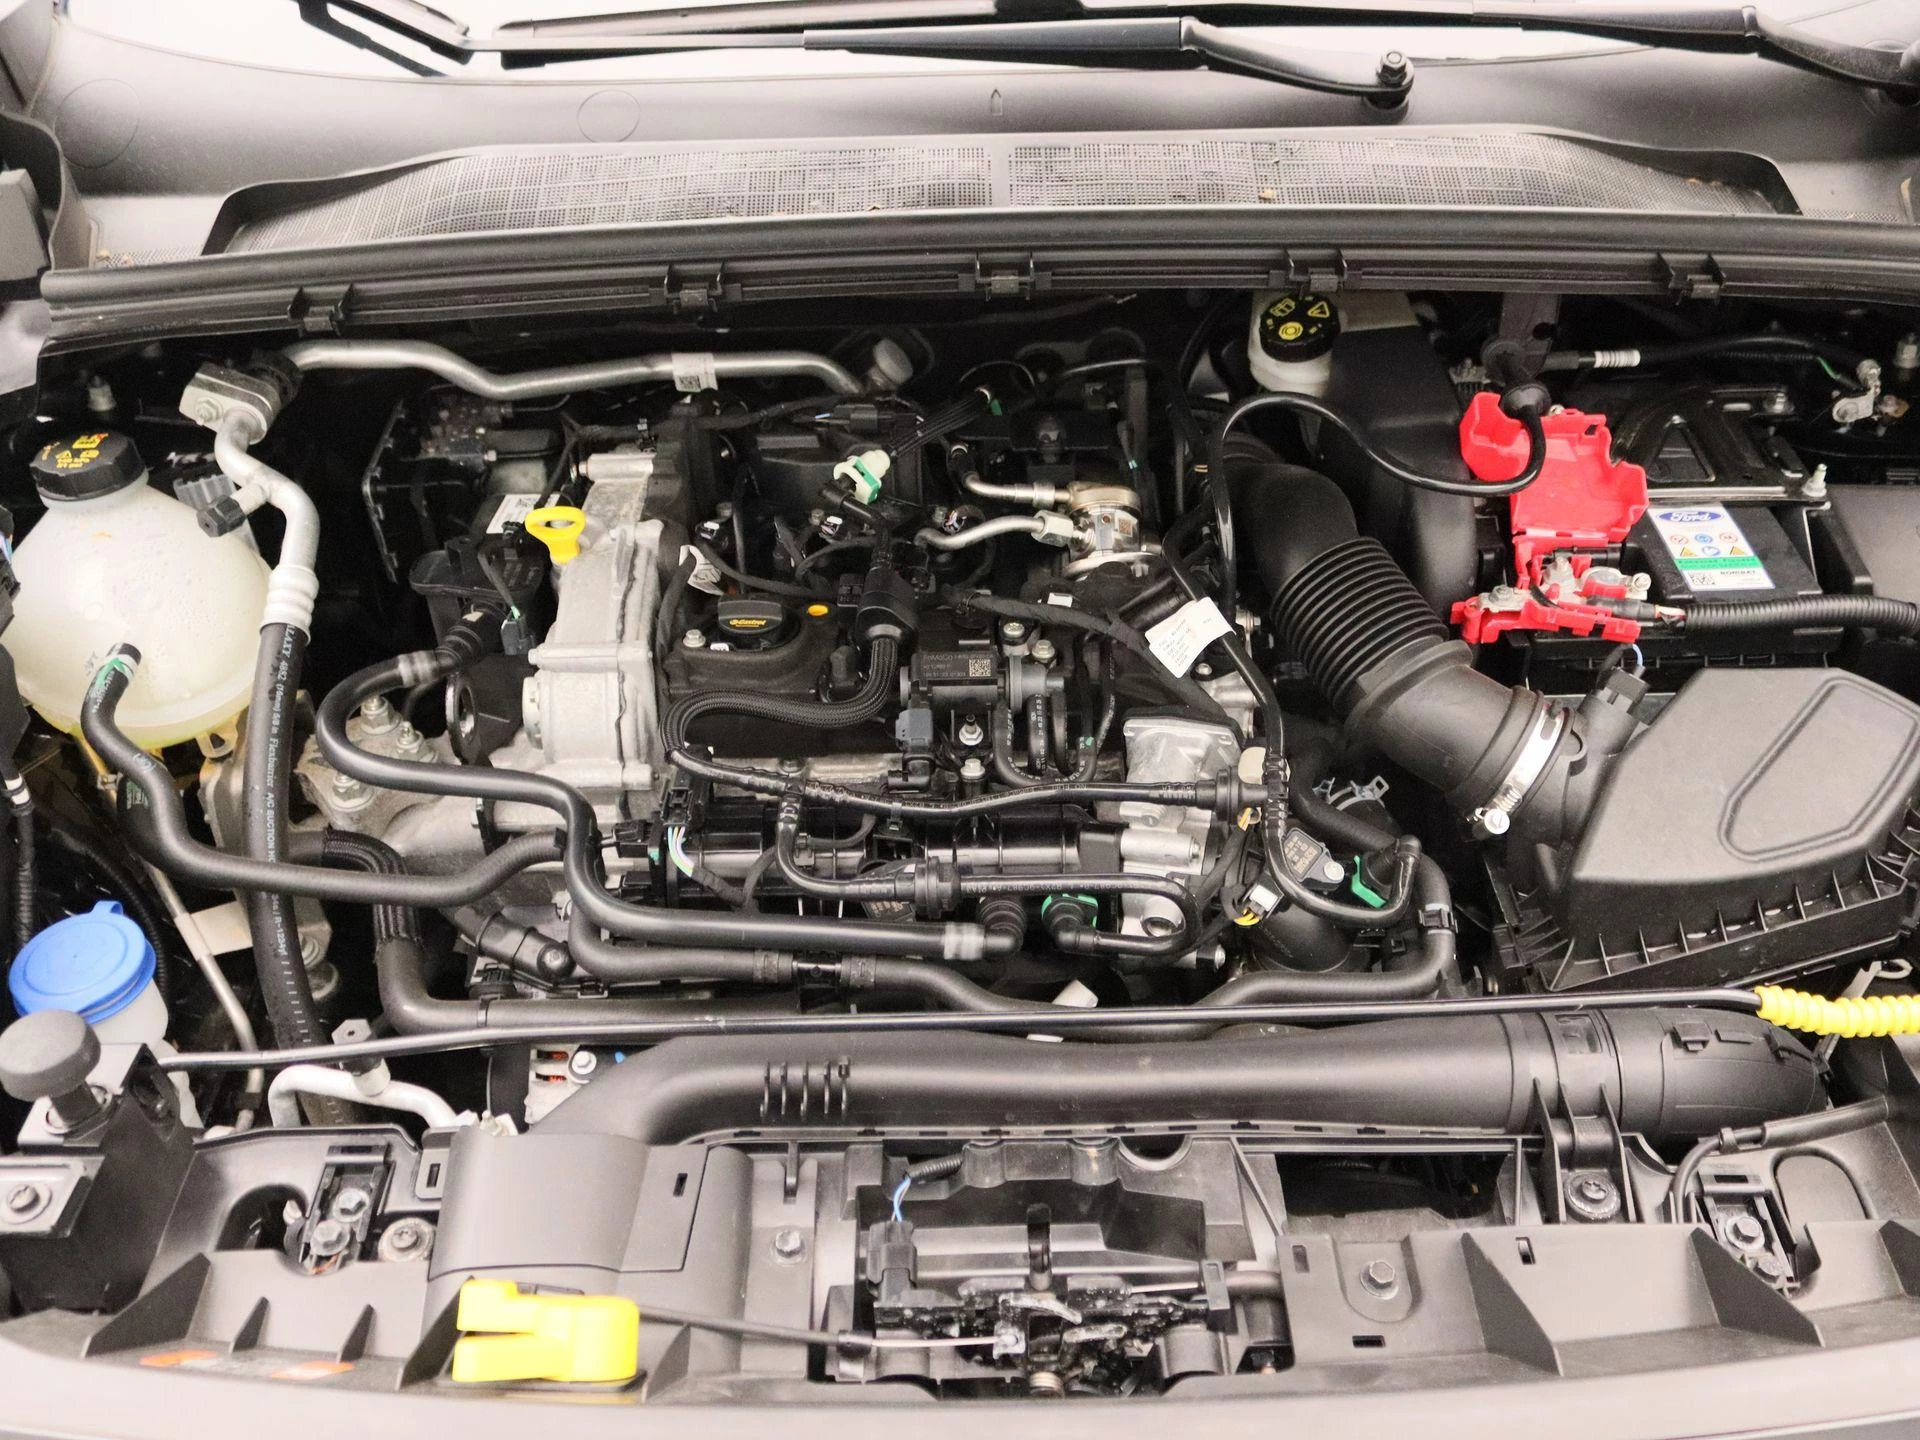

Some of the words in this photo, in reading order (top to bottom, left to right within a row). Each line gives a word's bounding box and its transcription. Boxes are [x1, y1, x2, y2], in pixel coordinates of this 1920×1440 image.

[1670, 511, 1712, 522] Ford
[266, 792, 275, 808] A/C
[267, 809, 276, 849] SUCTION
